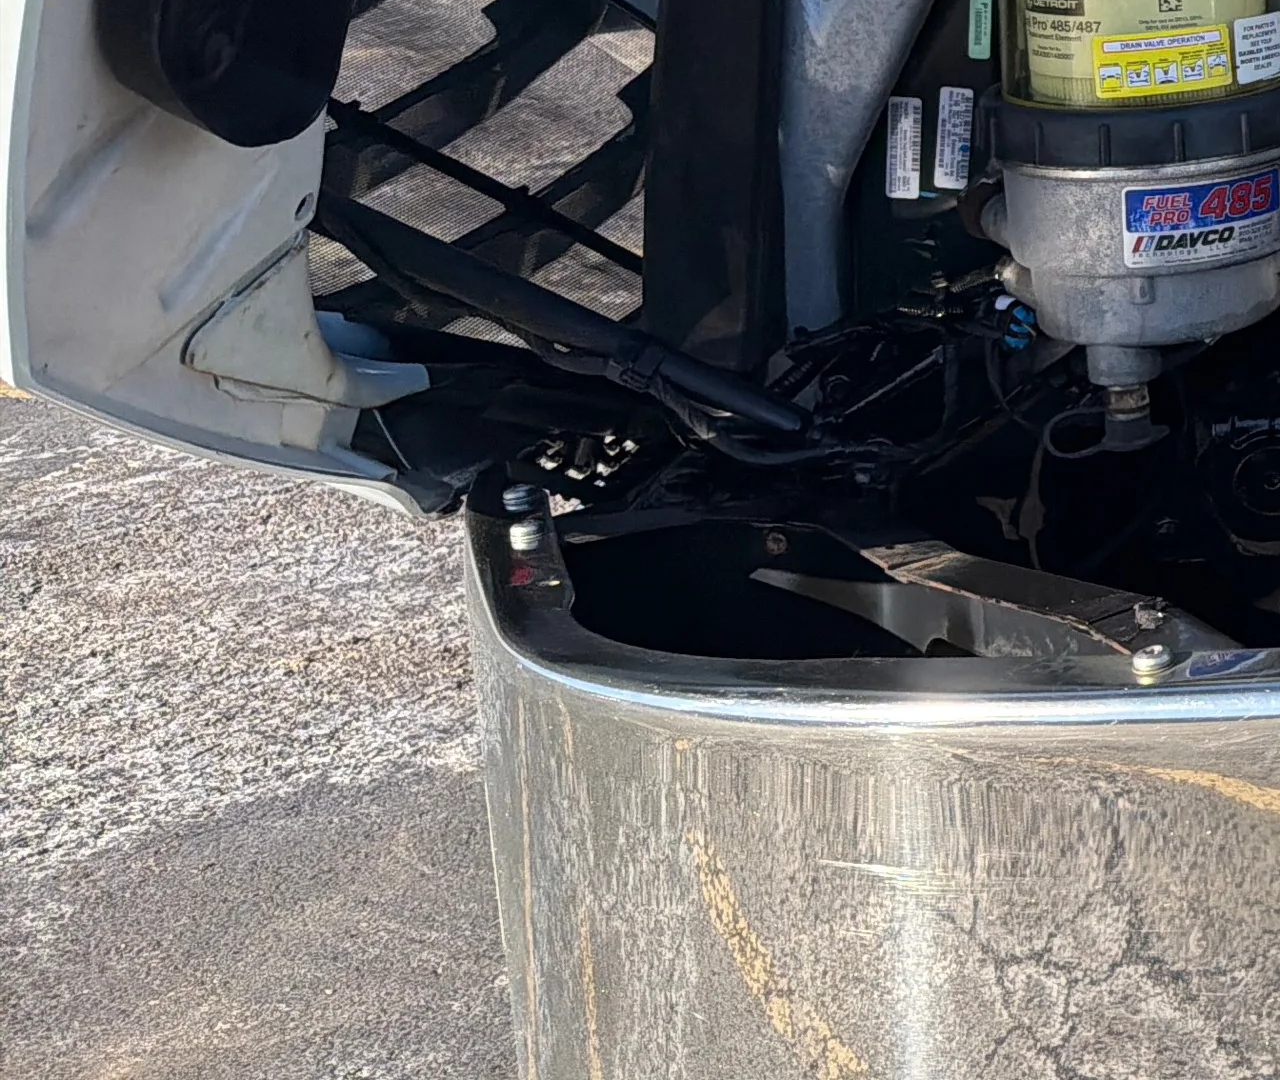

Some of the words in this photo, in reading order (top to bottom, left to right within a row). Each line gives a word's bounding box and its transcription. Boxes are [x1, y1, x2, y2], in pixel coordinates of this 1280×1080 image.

[1032, 16, 1047, 31] Pro
[1050, 19, 1102, 33] 485/487
[1120, 41, 1142, 49] DRAIN
[1143, 39, 1165, 47] VALVE
[1168, 35, 1206, 45] OPERATION
[1238, 48, 1263, 57] DAIMLER
[1143, 193, 1192, 210] FUEL
[1198, 174, 1273, 220] 485
[1149, 210, 1191, 226] PRO
[1154, 226, 1235, 250] DAVCO
